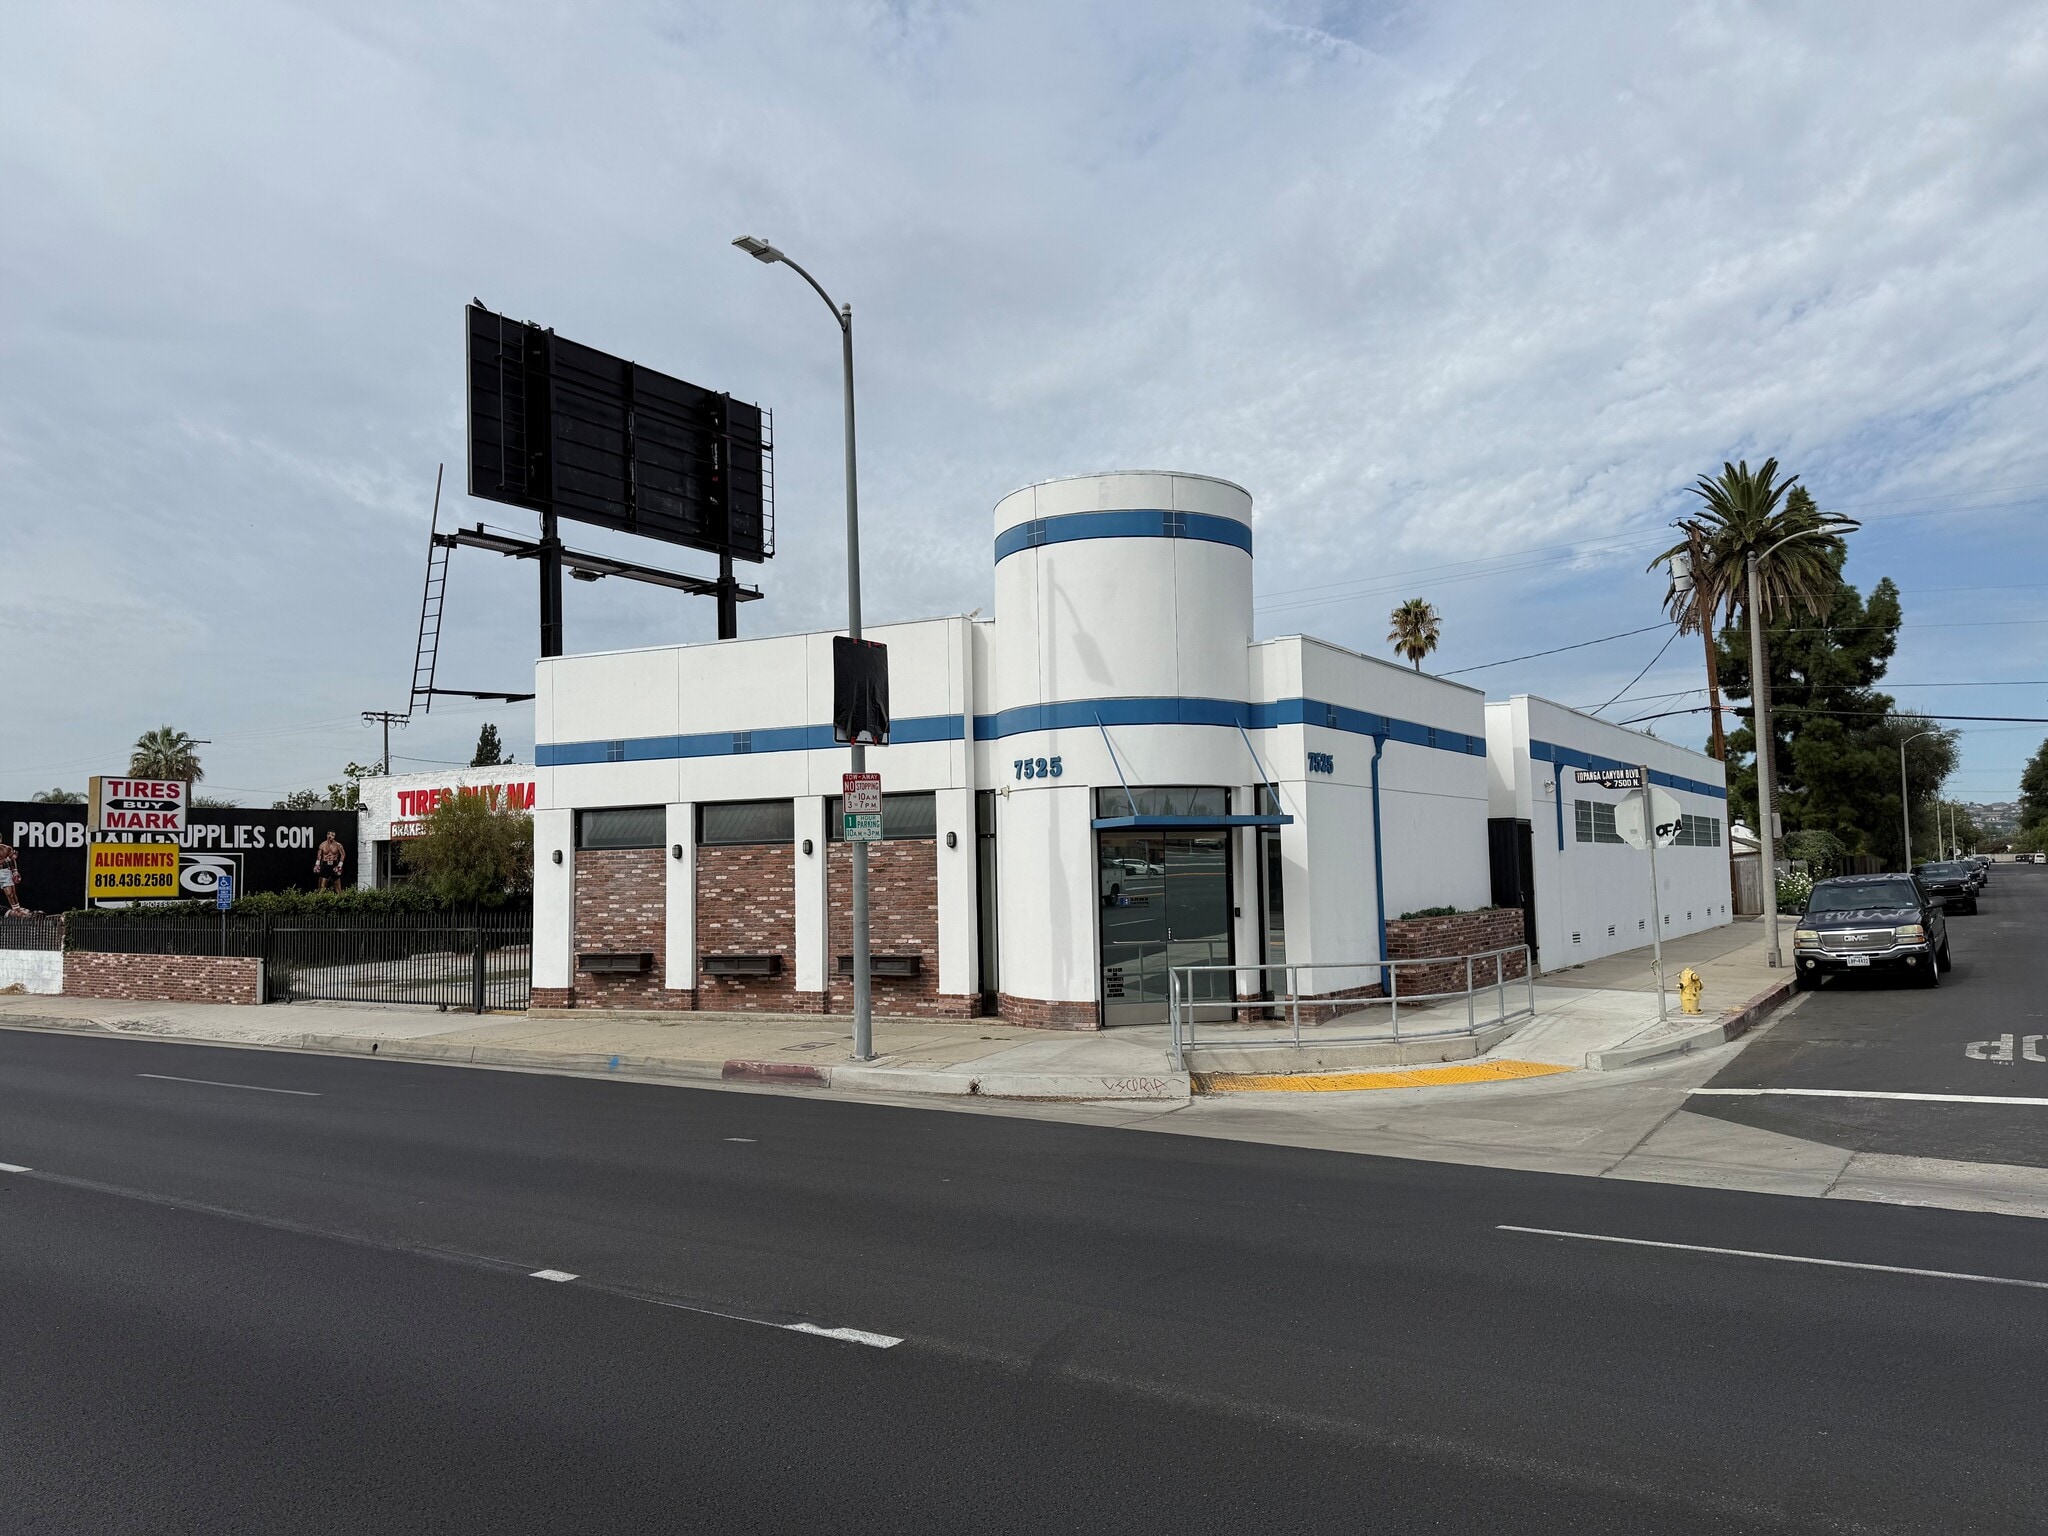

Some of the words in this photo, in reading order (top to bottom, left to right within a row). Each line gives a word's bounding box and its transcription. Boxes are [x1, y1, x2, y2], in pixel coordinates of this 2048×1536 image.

[1013, 755, 1063, 780] 7525
[1308, 751, 1334, 774] 7525
[1576, 770, 1601, 782] TOPANGA
[1602, 769, 1624, 780] CANYON
[1625, 768, 1640, 779] BLVD.
[107, 780, 180, 799] TIRES
[845, 781, 855, 792] NO
[856, 782, 879, 791] STOPPING
[123, 801, 164, 809] BUY
[106, 812, 179, 829] MARK
[848, 816, 852, 827] 1
[94, 852, 174, 867] ALIGNMENTS
[95, 873, 173, 887] 818.436.2580
